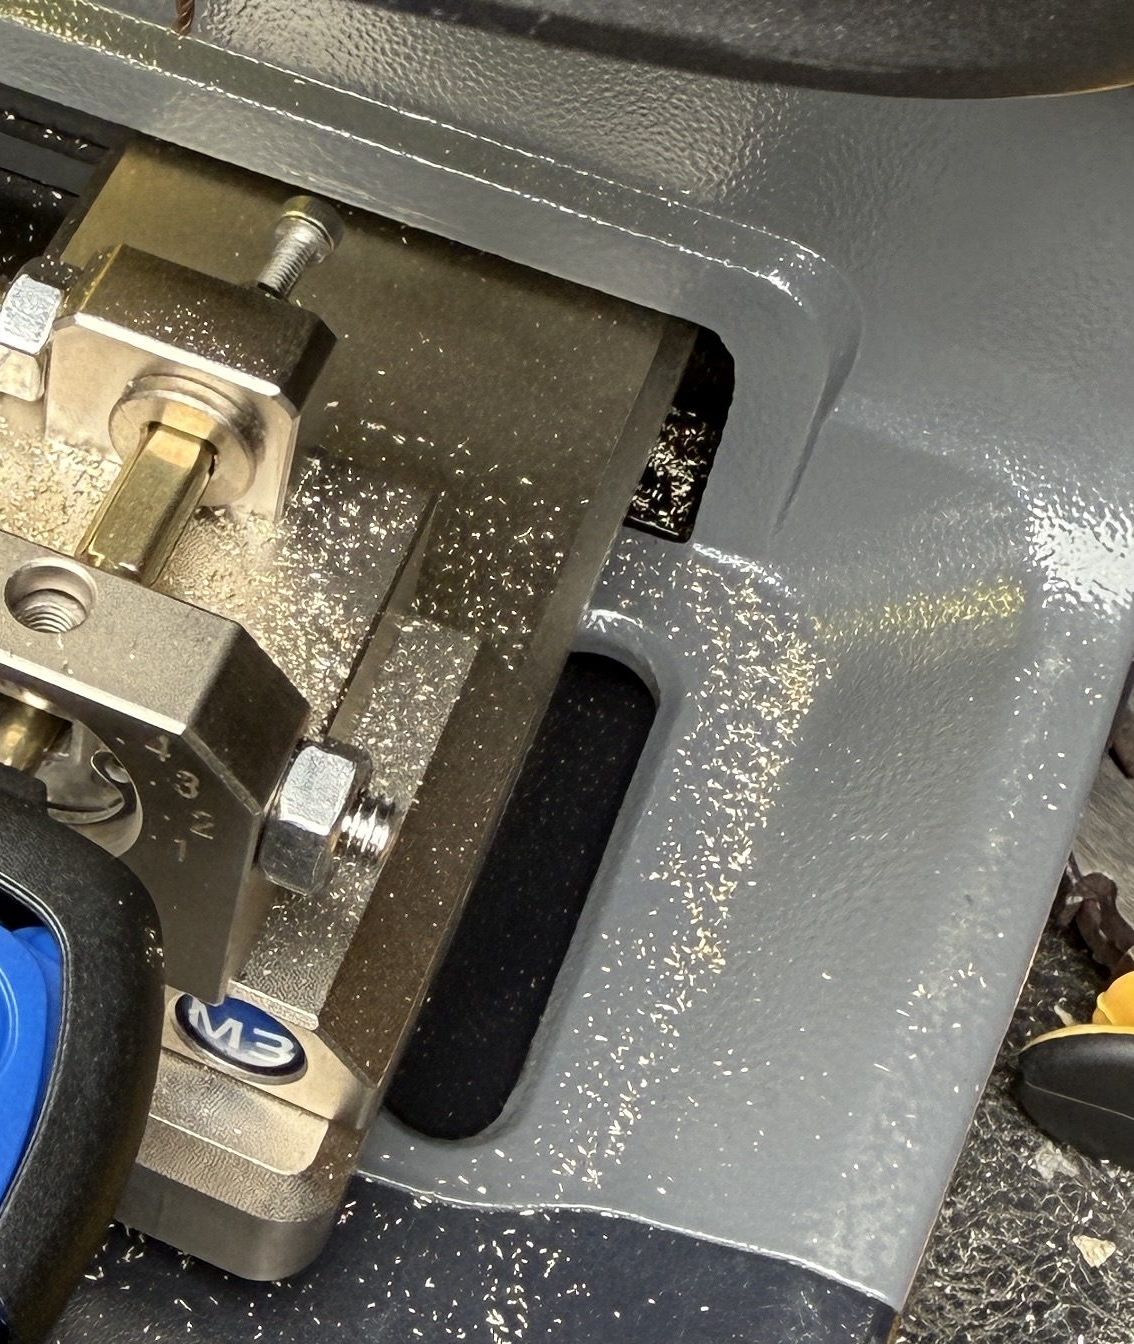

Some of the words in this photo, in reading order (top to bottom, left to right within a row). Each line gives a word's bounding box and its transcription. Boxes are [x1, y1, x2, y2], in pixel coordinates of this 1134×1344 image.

[172, 769, 200, 800] 3
[189, 810, 215, 840] 2
[187, 998, 296, 1067] M3
